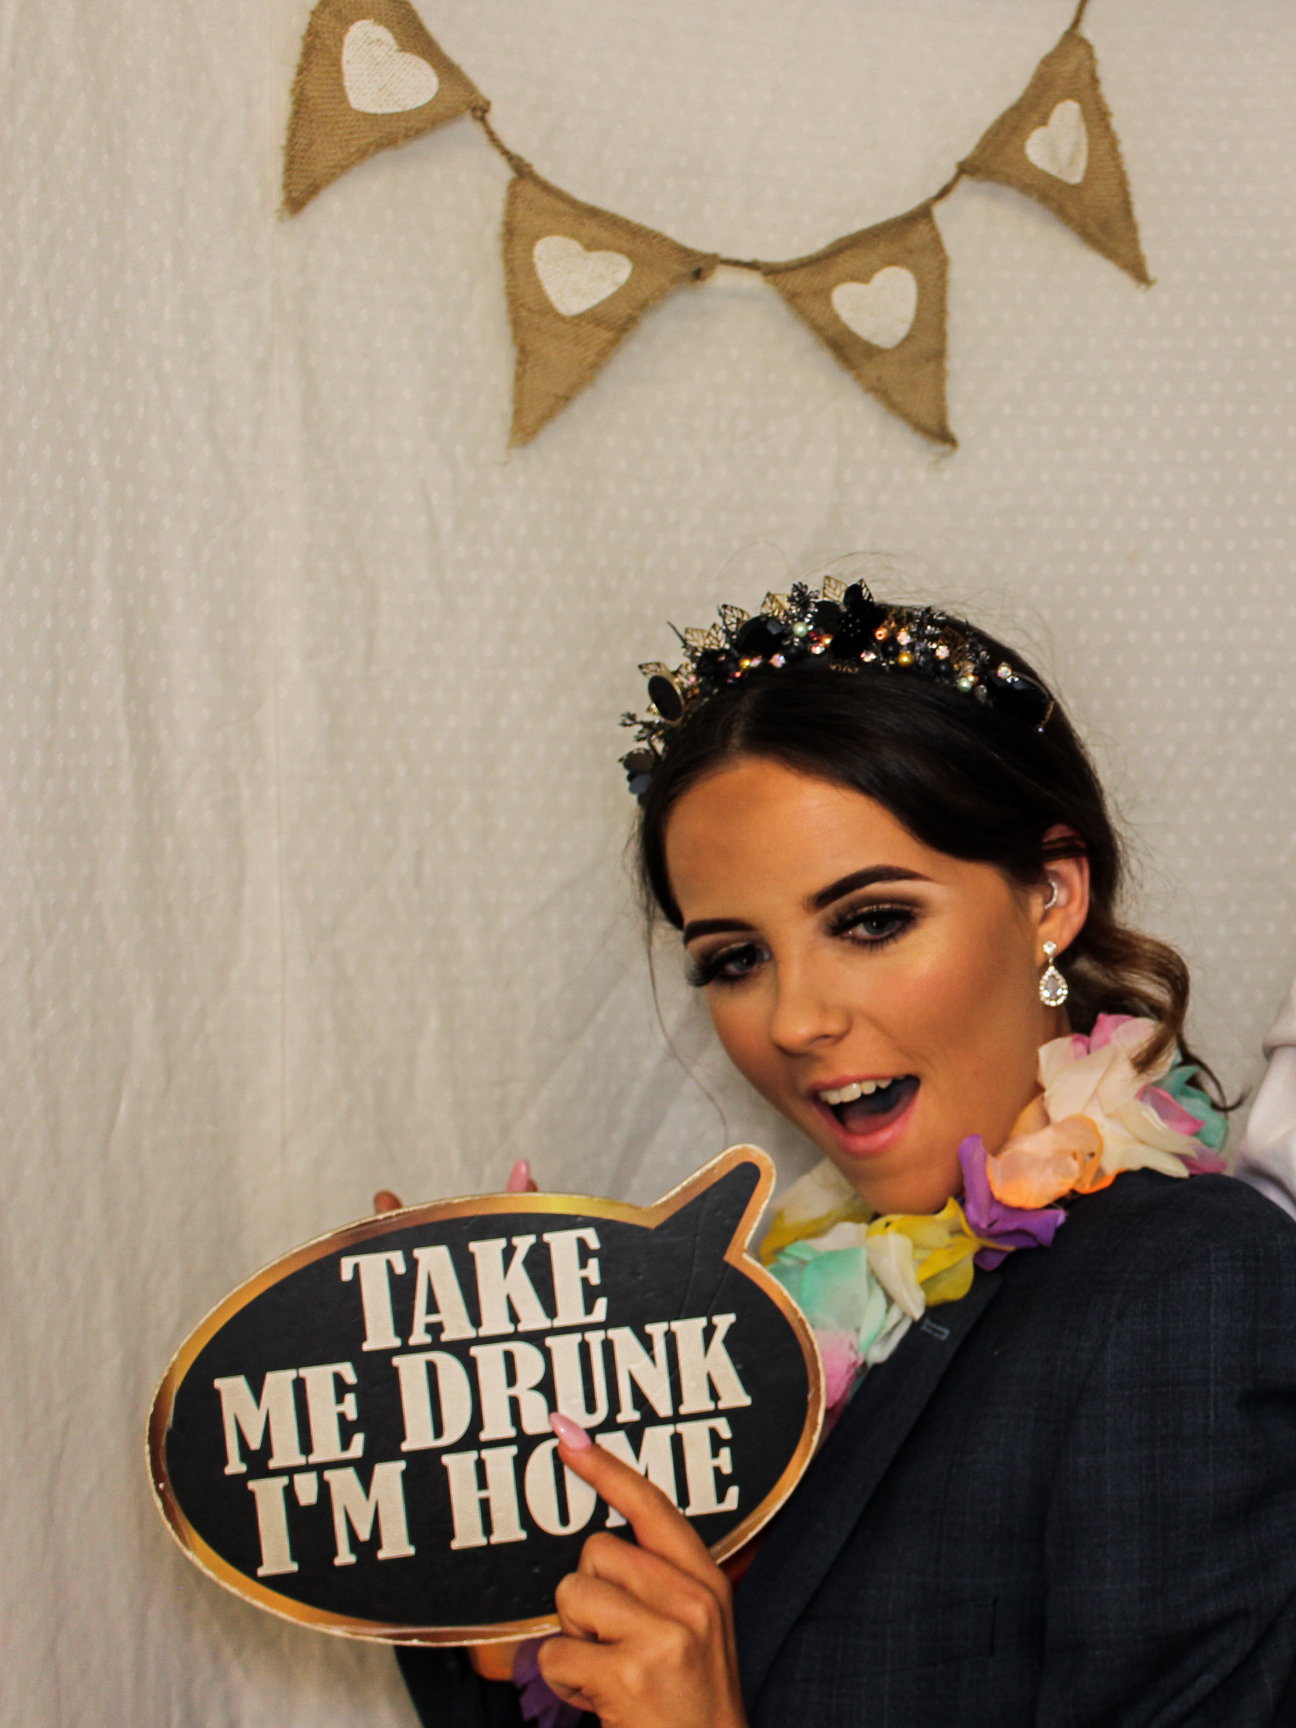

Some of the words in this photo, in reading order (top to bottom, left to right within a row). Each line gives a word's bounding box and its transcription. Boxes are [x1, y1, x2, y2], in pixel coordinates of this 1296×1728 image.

[341, 1227, 607, 1351] TAKE
[214, 1362, 365, 1475] ME
[392, 1313, 751, 1452] DRUNK
[248, 1460, 415, 1577] I'M
